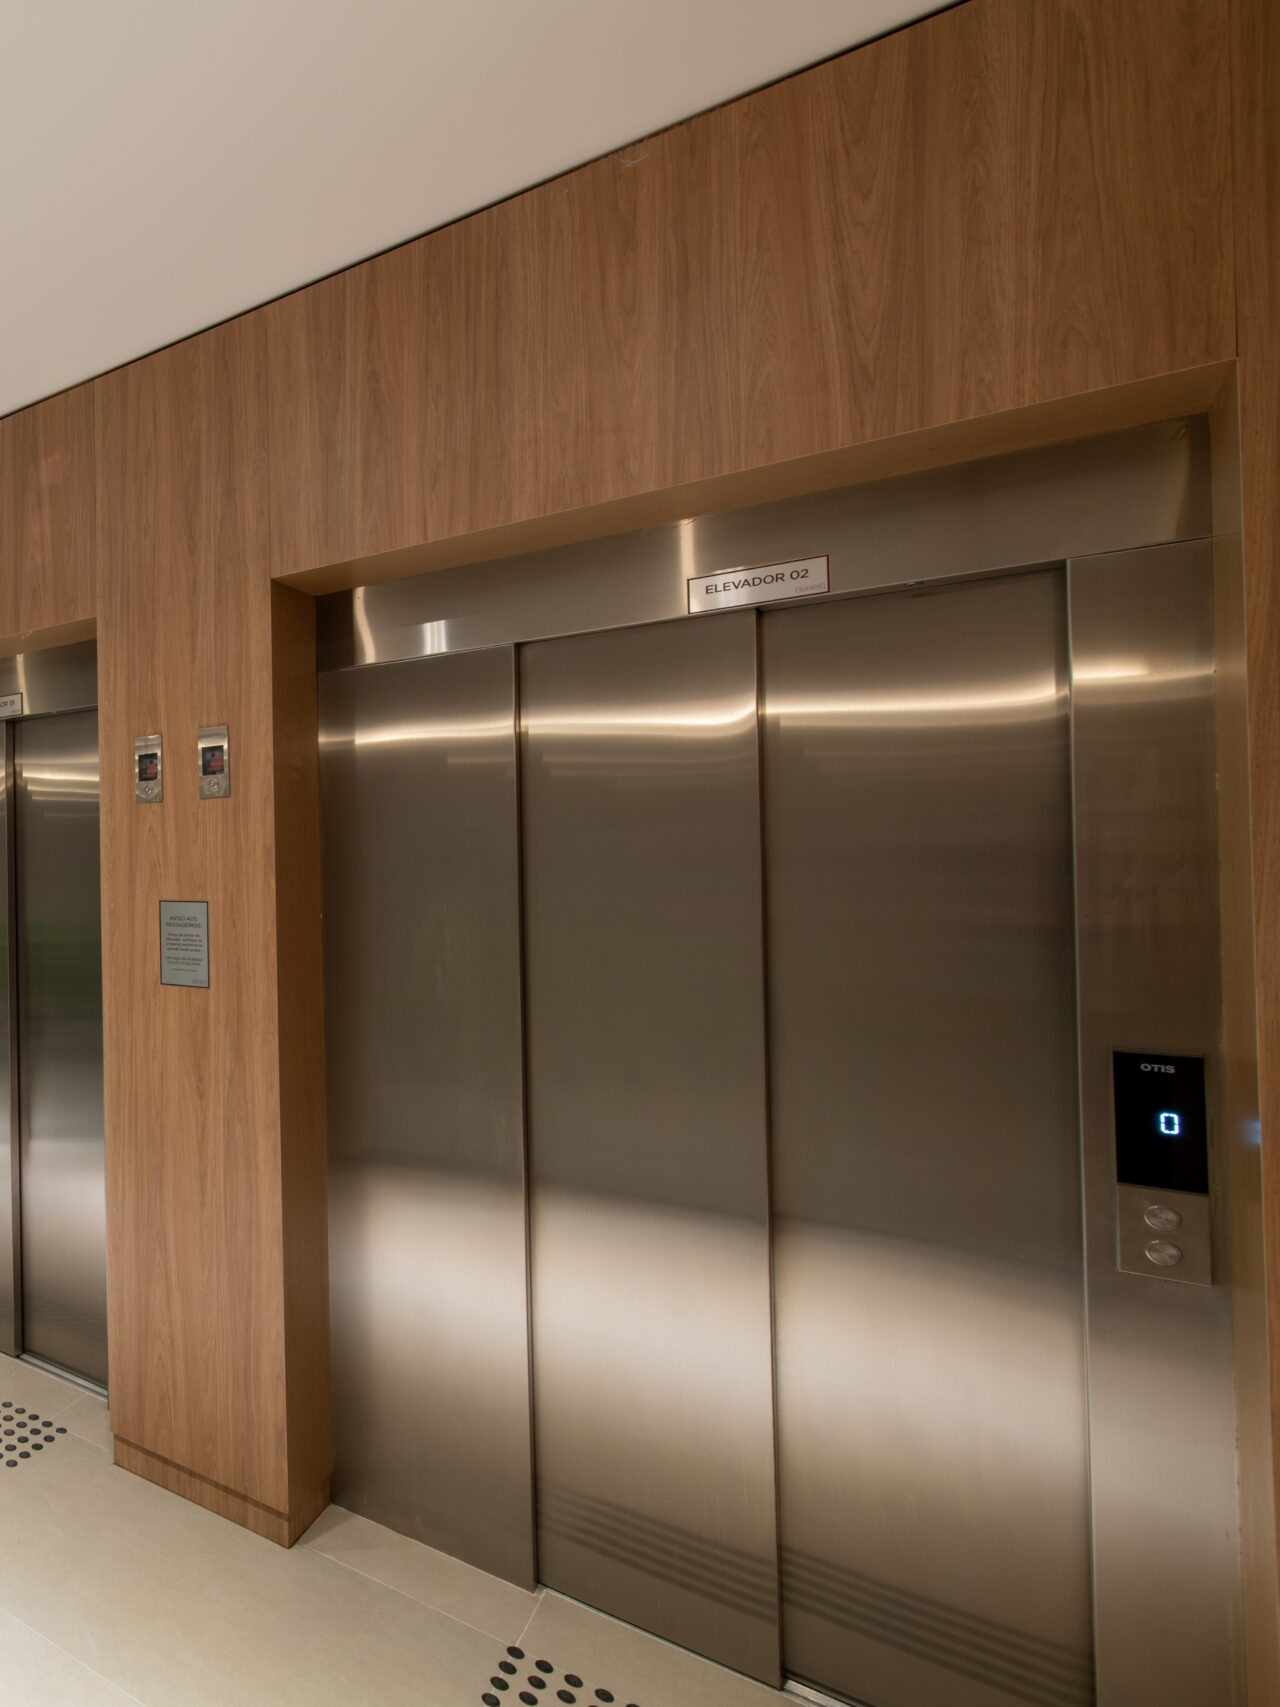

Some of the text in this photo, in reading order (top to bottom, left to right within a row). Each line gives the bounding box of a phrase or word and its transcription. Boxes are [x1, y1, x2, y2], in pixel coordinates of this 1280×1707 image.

[705, 572, 785, 595] ELEVADOR
[790, 568, 809, 580] 02
[1140, 1063, 1175, 1074] OTIS
[1160, 1112, 1180, 1135] 0
